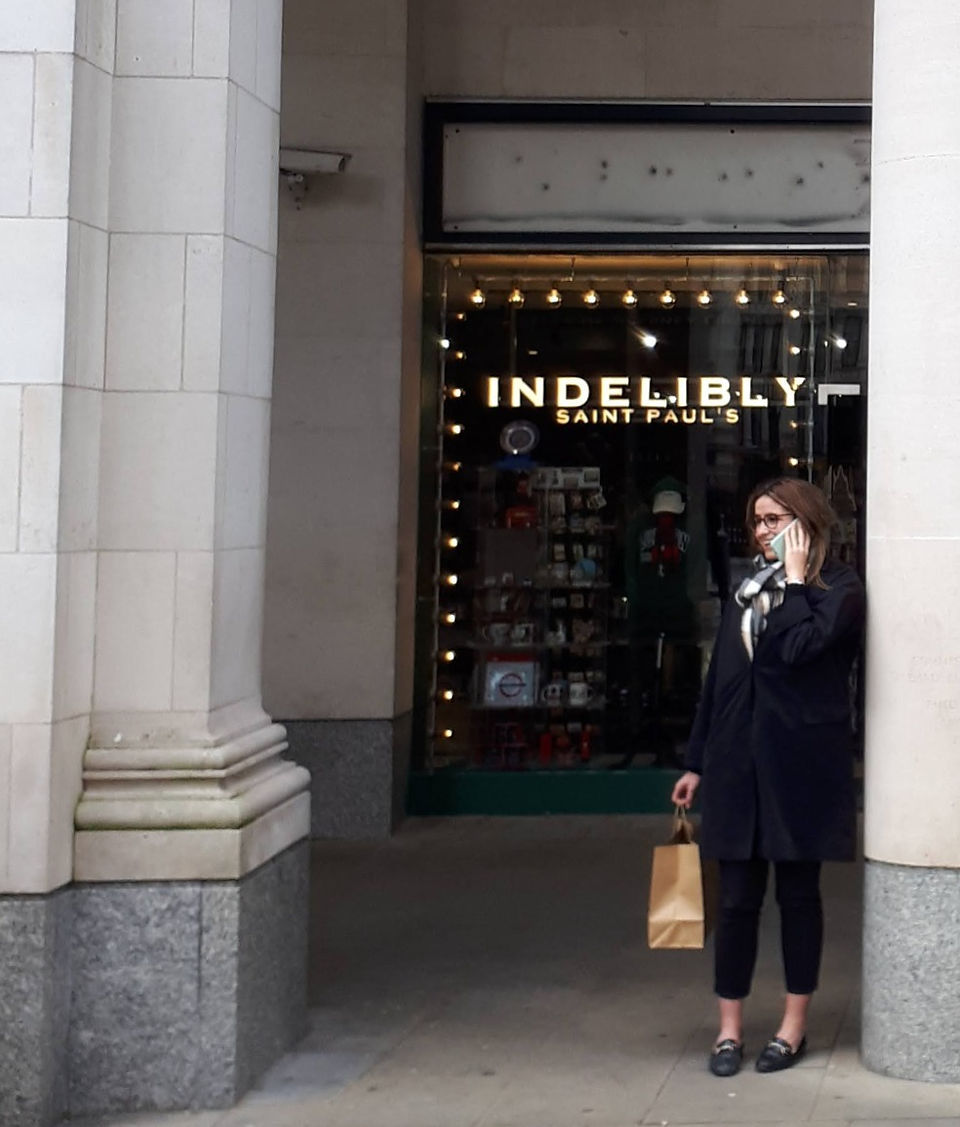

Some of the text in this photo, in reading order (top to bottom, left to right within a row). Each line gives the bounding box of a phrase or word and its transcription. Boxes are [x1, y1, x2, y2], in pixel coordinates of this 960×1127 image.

[487, 376, 806, 408] INDELIBLY
[556, 407, 740, 424] SAINT PAUL'S
